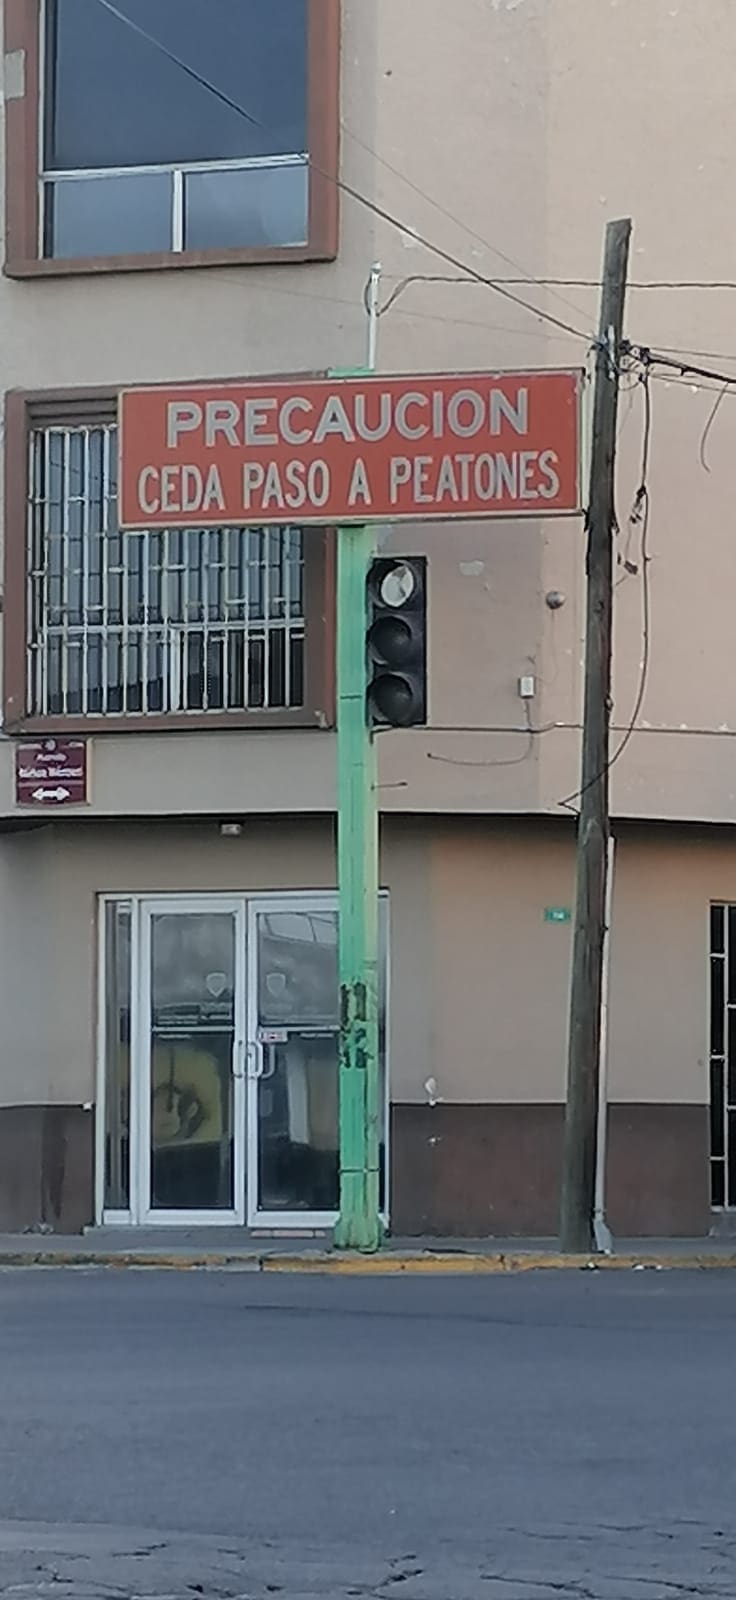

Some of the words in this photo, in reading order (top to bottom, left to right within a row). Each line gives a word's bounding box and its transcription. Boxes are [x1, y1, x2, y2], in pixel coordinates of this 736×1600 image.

[166, 387, 529, 449] PRECAUCION
[137, 463, 226, 514] CEDA
[243, 458, 330, 510] PASO
[347, 457, 372, 506] A
[390, 449, 560, 504] PEATONES
